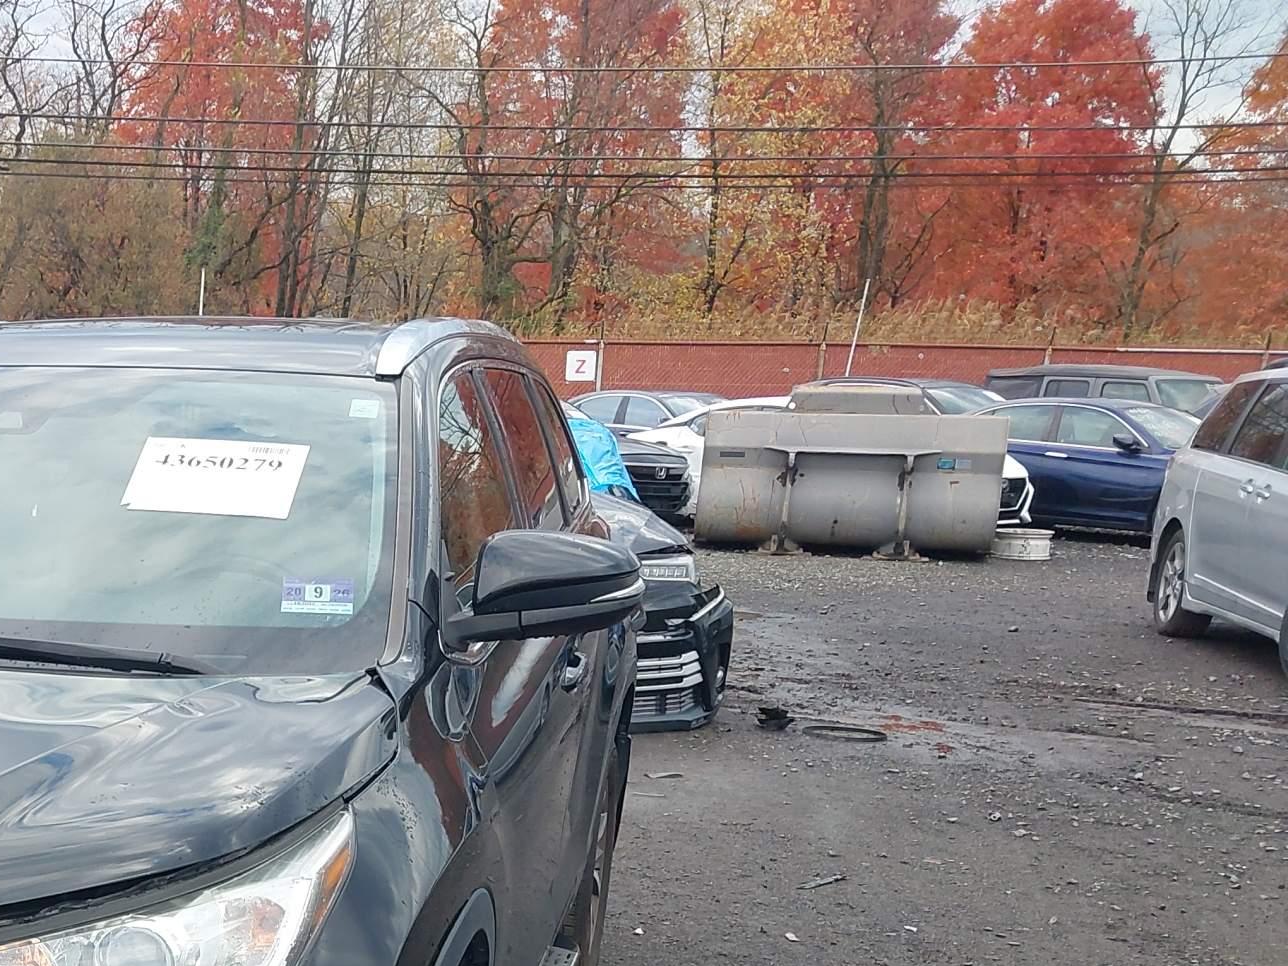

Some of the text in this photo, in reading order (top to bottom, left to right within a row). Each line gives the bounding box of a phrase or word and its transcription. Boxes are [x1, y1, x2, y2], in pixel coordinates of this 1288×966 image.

[574, 359, 587, 374] Z
[154, 453, 284, 472] 43650279
[313, 586, 324, 599] 9
